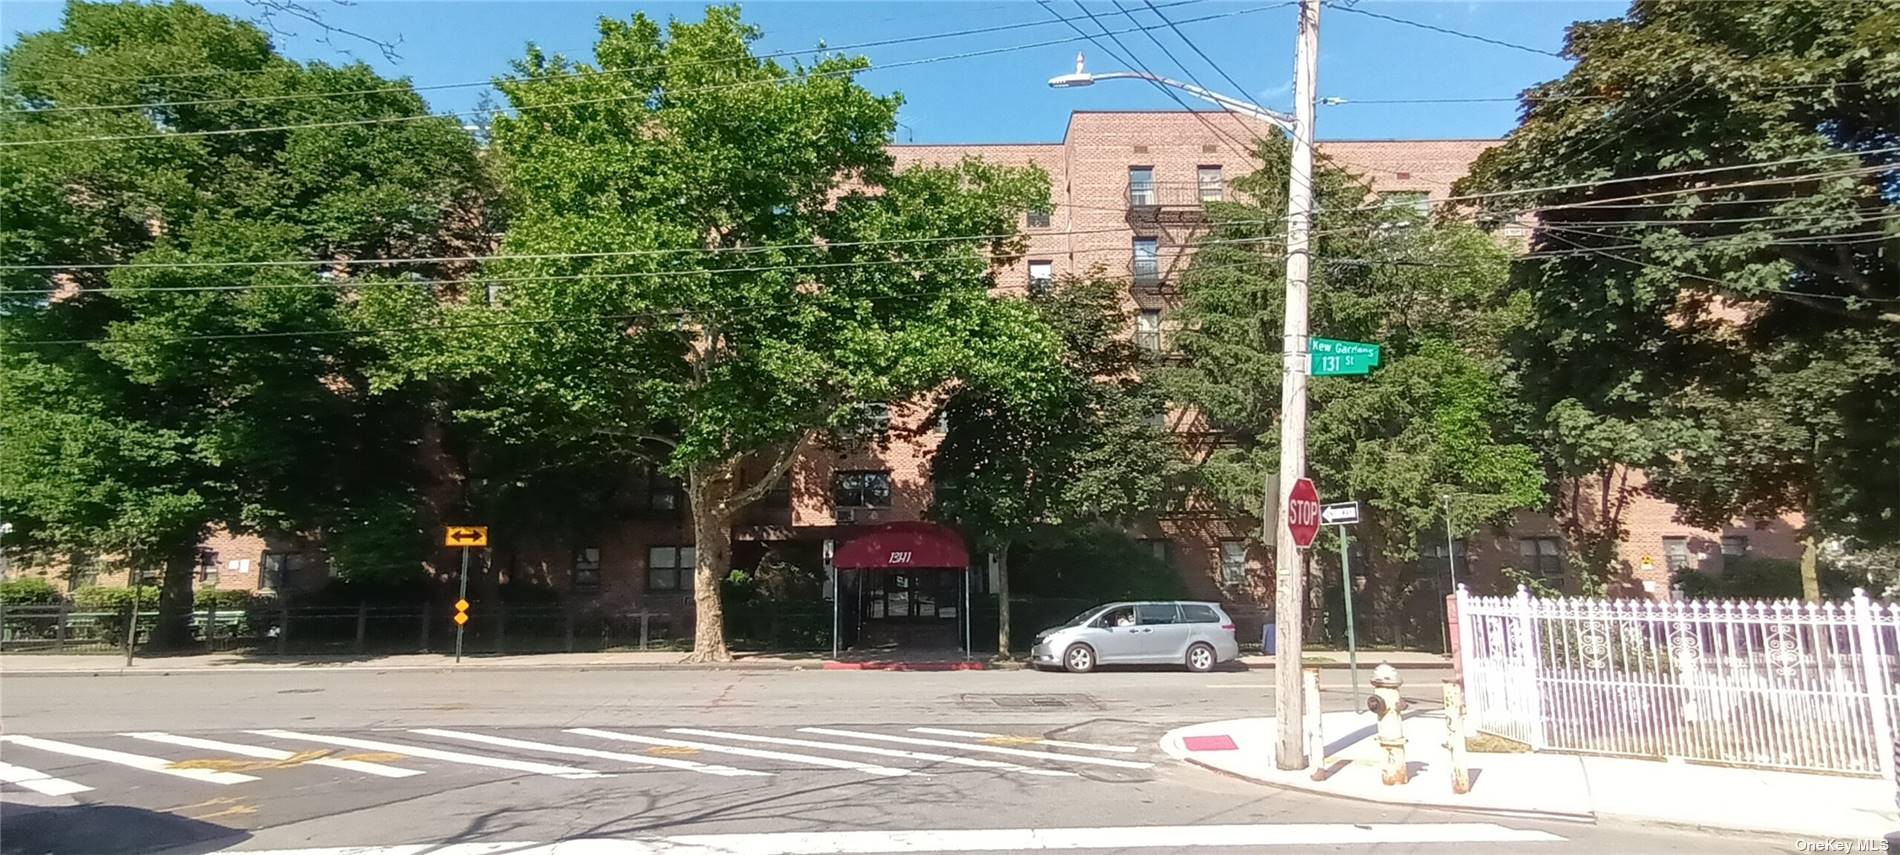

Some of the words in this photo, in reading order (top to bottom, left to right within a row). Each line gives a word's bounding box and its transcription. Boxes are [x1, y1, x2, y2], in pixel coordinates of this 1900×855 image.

[1312, 340, 1331, 352] Kew
[1335, 343, 1374, 357] Gardens
[1322, 356, 1340, 371] 131
[1345, 355, 1354, 366] St
[1290, 499, 1318, 526] STOP
